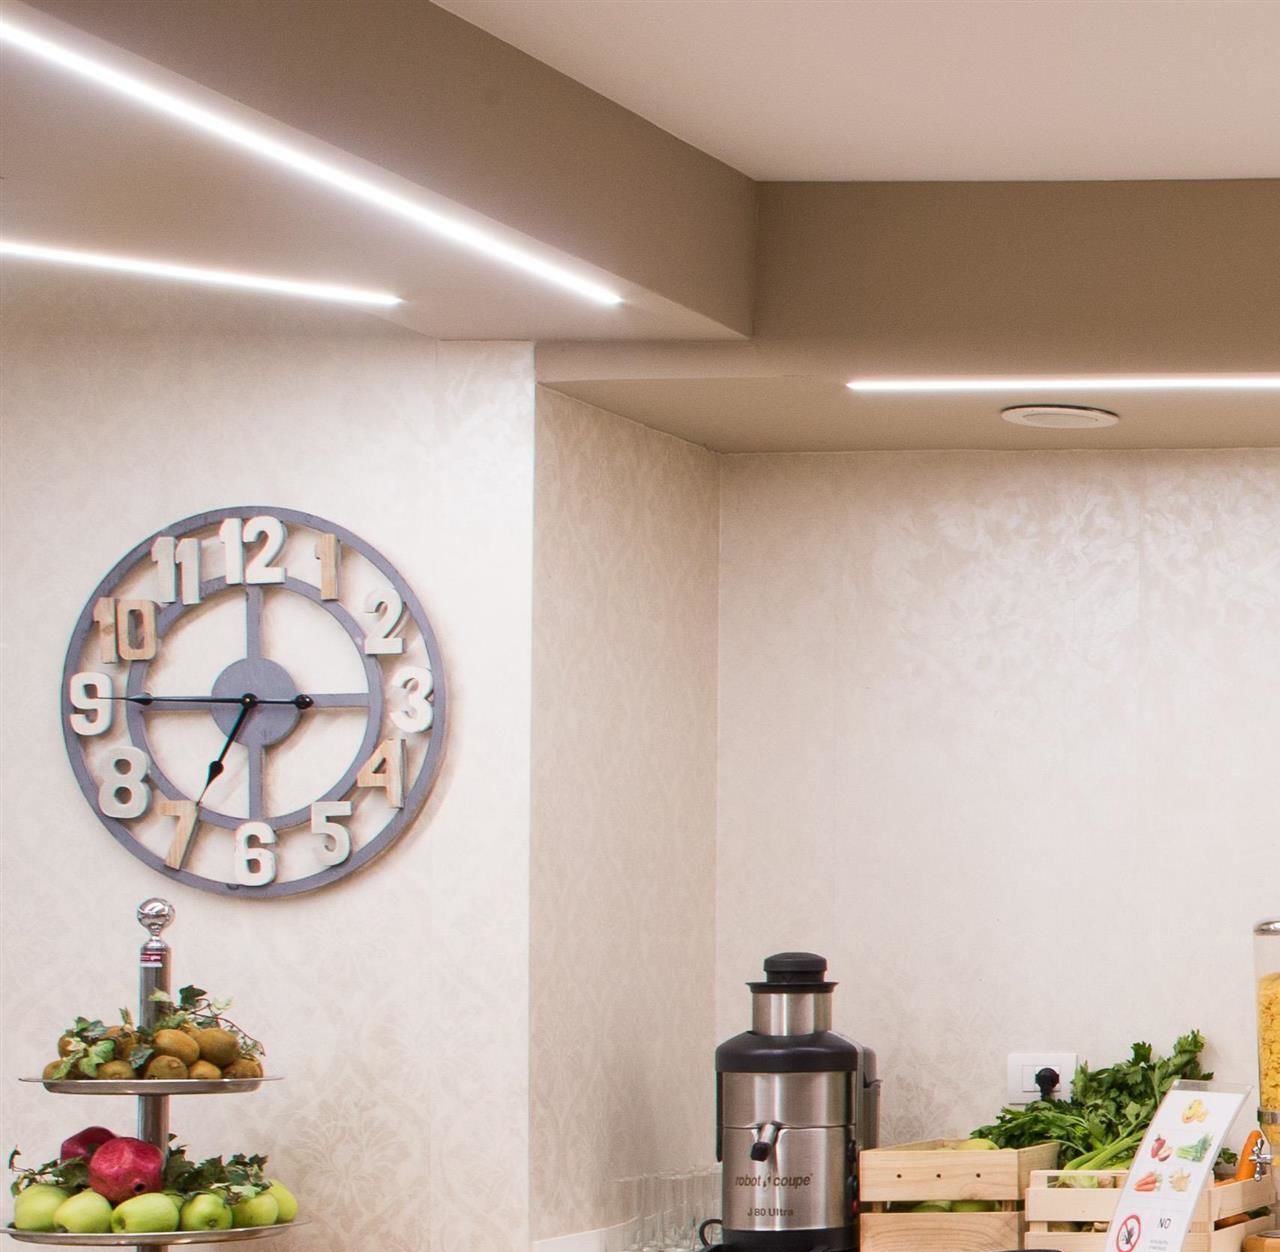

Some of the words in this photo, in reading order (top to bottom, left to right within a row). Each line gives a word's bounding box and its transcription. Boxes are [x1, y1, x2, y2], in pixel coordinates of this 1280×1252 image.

[152, 536, 201, 604] 11
[219, 516, 287, 585] 12
[315, 533, 341, 600] 1
[93, 597, 157, 664] 10
[365, 587, 404, 655] 2
[70, 672, 113, 735] 9
[391, 667, 434, 734] 3
[99, 746, 150, 819] 8
[358, 738, 406, 809] 4
[160, 801, 199, 870] 7
[234, 822, 277, 887] 6
[312, 801, 352, 866] 5
[735, 1174, 761, 1187] robot
[768, 1208, 794, 1216] Ultra
[1159, 1217, 1171, 1229] NO
